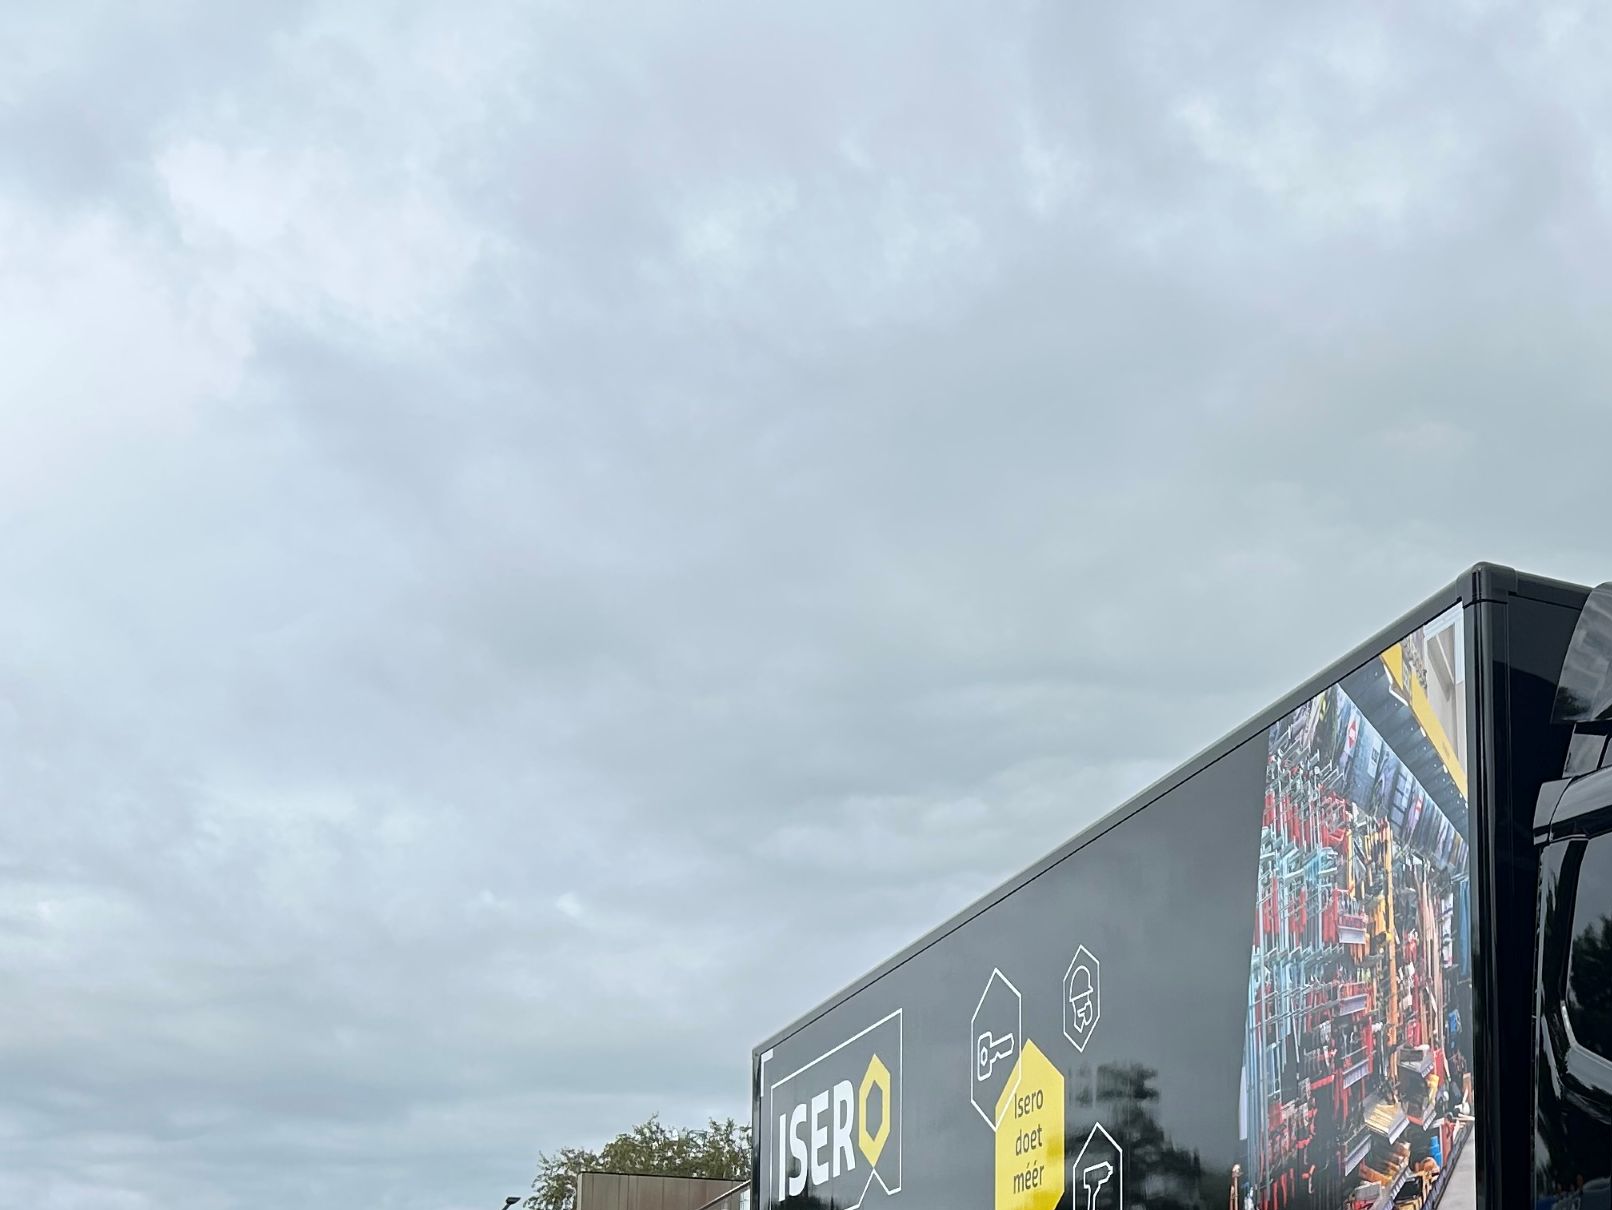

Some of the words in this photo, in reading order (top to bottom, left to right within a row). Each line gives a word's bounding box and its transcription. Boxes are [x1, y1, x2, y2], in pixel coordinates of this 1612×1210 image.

[1014, 1088, 1045, 1119] Isero
[1015, 1127, 1043, 1156] doet
[1013, 1162, 1045, 1195] méér
